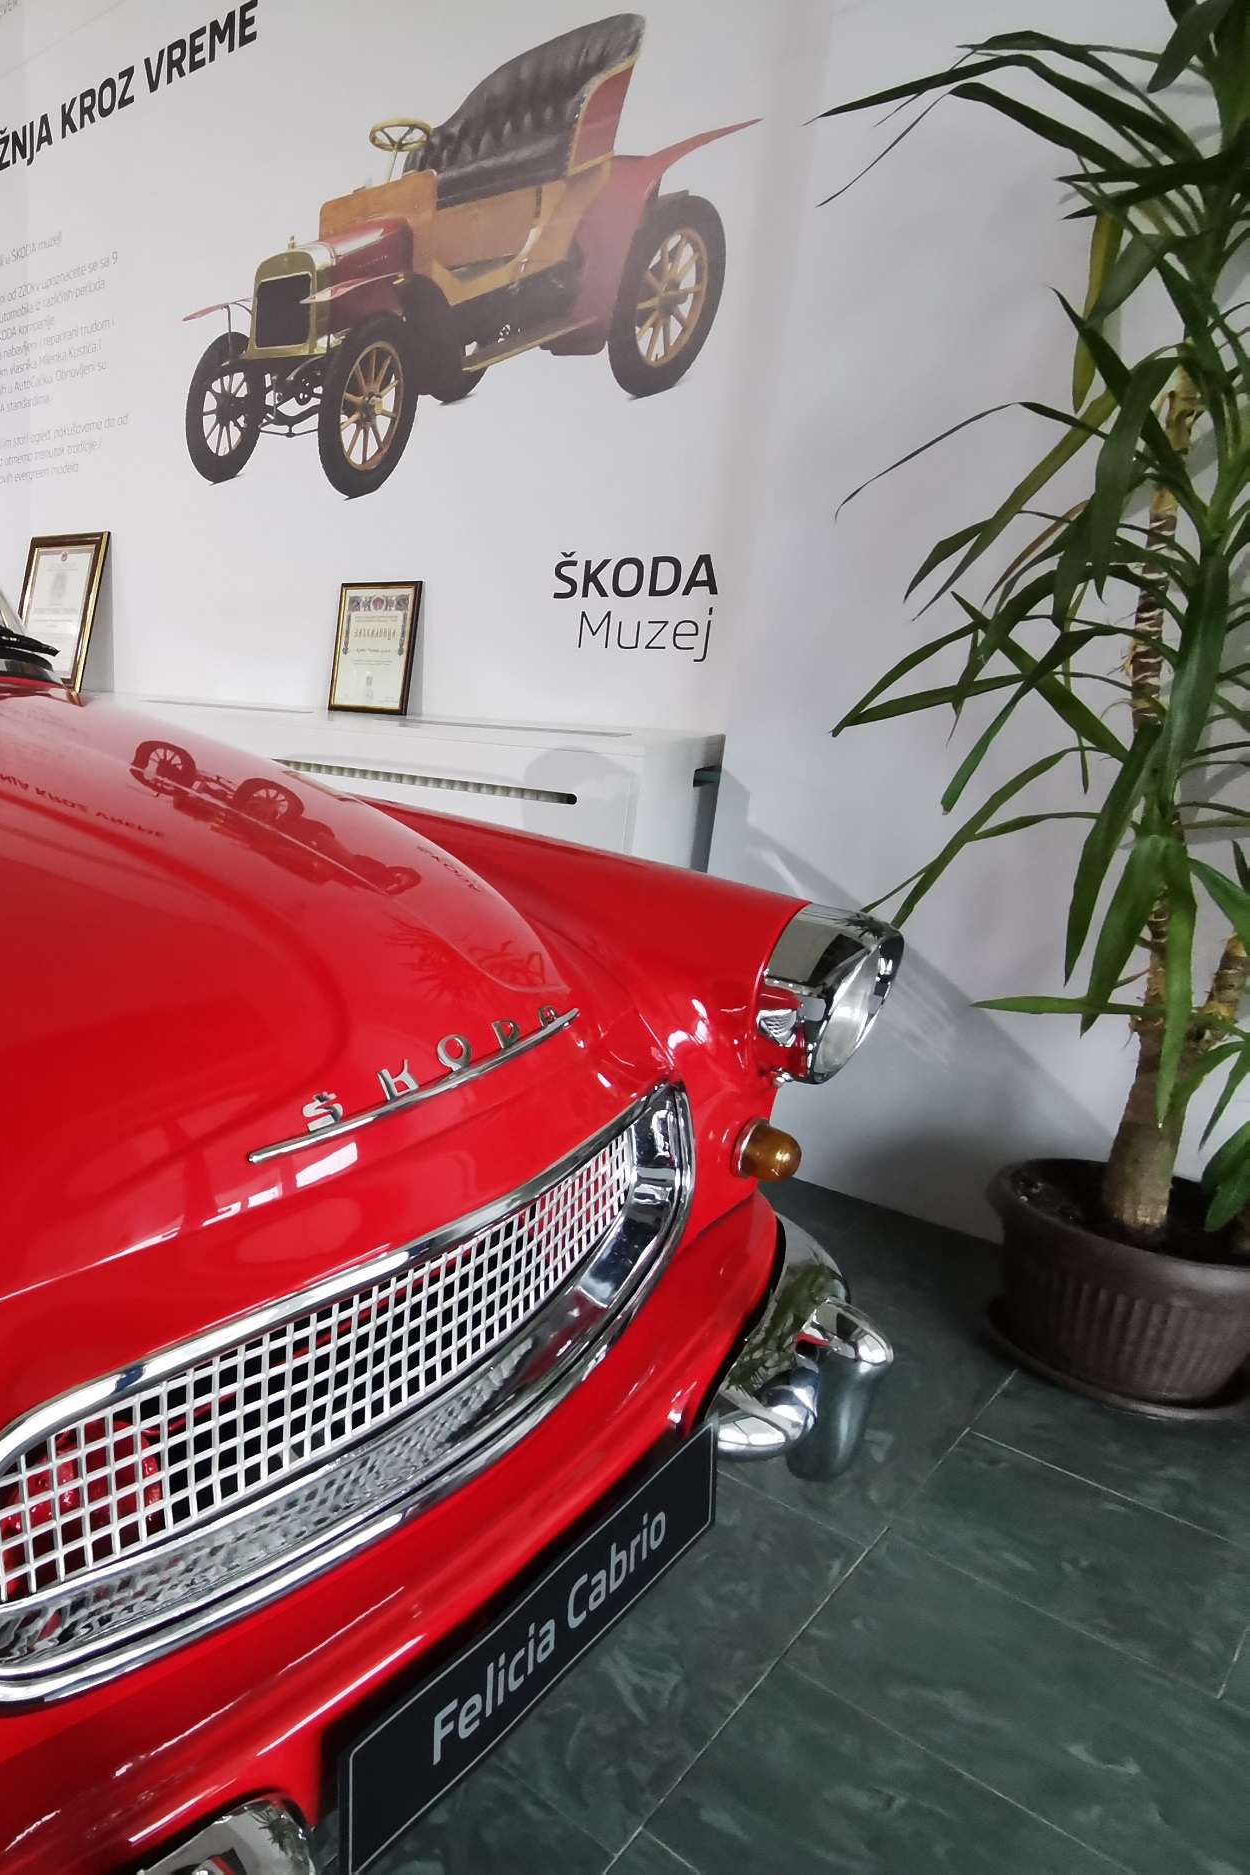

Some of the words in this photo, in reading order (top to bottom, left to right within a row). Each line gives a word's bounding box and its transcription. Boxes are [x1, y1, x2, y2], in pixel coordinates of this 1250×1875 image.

[61, 65, 135, 139] KROZ
[144, 0, 258, 93] VREME
[4, 256, 10, 265] u
[11, 242, 37, 262] ŠKODA
[7, 287, 17, 302] od
[88, 261, 98, 273] se
[100, 257, 109, 269] sa
[111, 251, 118, 265] 9
[75, 278, 105, 300] perioda
[19, 315, 54, 335] kompanije
[43, 326, 78, 346] reparirani
[80, 320, 110, 336] trudom
[7, 385, 13, 394] u
[55, 363, 95, 382] Obnovljeni
[97, 360, 107, 371] su
[9, 358, 37, 375] vlasnika
[13, 432, 29, 447] stari
[53, 423, 102, 441] pokušavamo
[104, 416, 115, 428] da
[117, 411, 129, 425] od
[34, 445, 65, 461] trenutak
[67, 440, 97, 455] tradicije
[14, 468, 49, 483] evergreen
[553, 551, 718, 599] ŠKODA
[578, 606, 713, 662] Muzej
[302, 1005, 559, 1132] ŠKODA
[433, 1619, 556, 1767] Felicia
[568, 1511, 666, 1619] Cabrio
